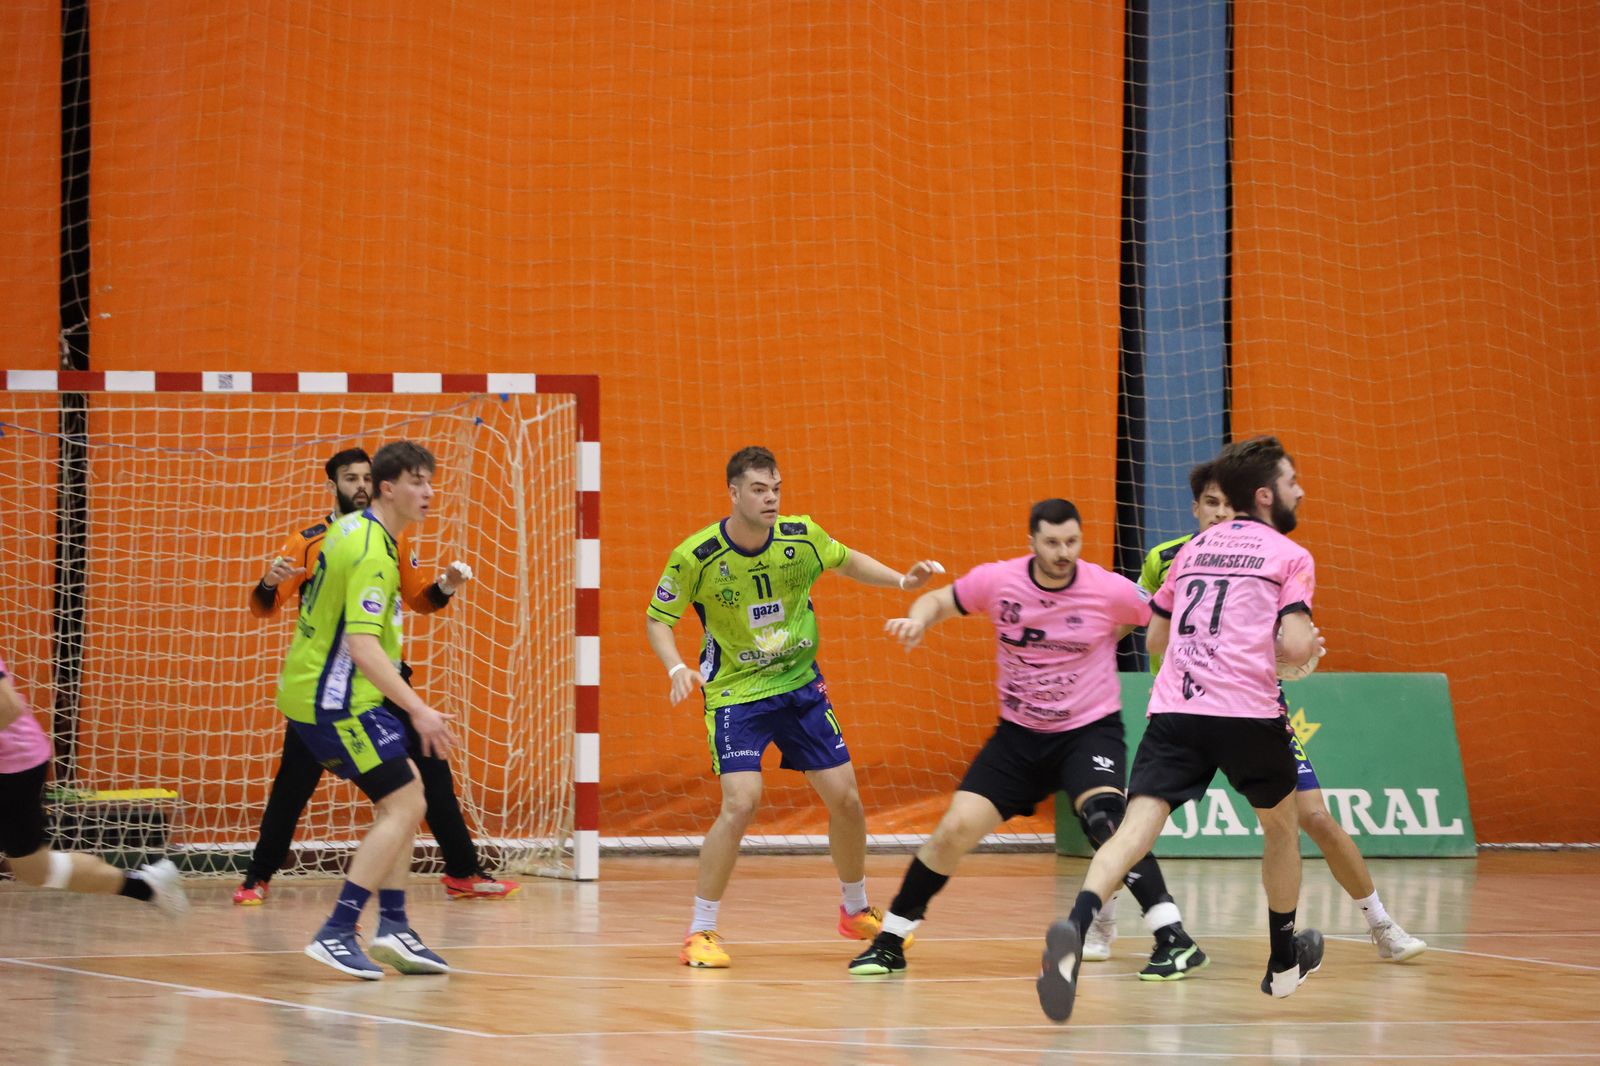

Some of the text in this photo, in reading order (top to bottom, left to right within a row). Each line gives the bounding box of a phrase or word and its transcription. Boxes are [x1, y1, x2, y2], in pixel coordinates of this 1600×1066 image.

[1194, 553, 1266, 570] REMESEIRO
[752, 573, 773, 599] 11
[752, 603, 780, 620] gaza
[1178, 579, 1230, 635] 21
